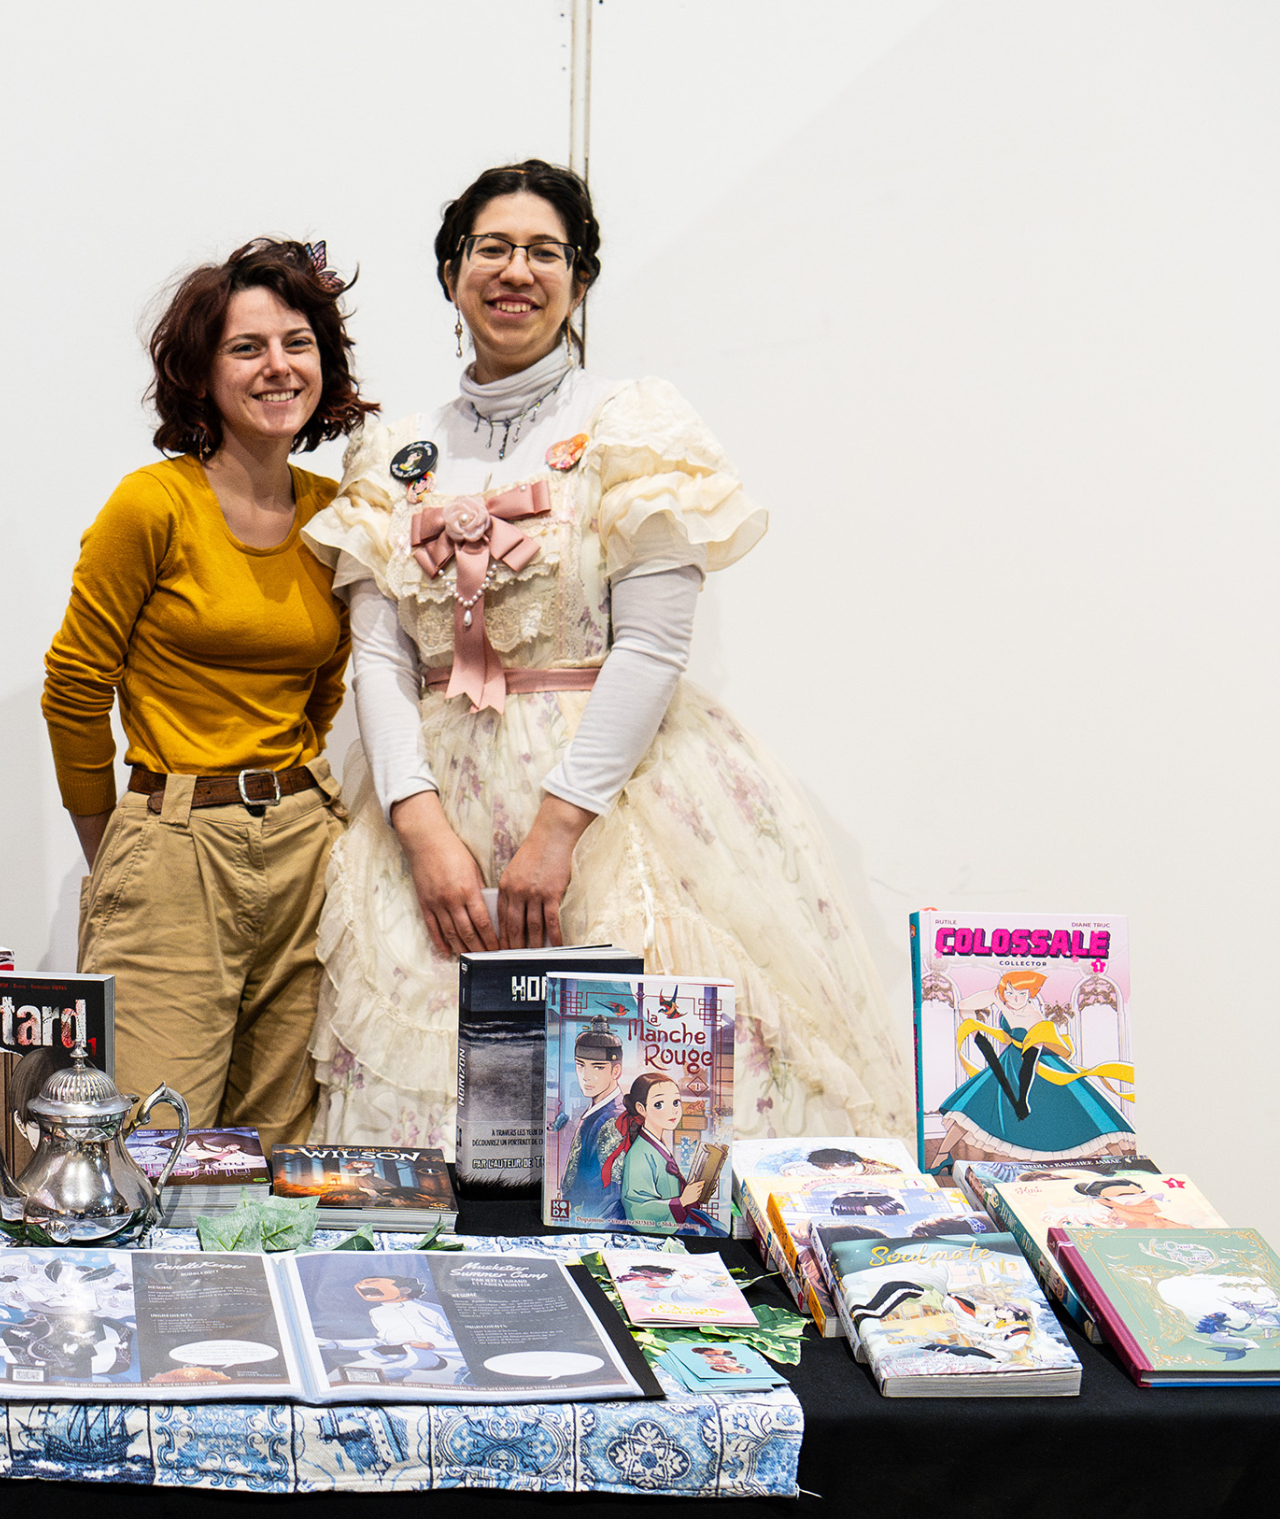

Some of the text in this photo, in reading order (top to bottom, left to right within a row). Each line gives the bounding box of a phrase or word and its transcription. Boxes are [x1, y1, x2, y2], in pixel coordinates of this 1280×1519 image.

[935, 927, 1111, 959] COLOSSALE
[1095, 961, 1101, 970] 1
[627, 1017, 707, 1048] Manche
[88, 1037, 97, 1056] 1
[644, 1045, 714, 1075] Rouge
[298, 1148, 421, 1162] WILSON
[472, 1159, 487, 1169] PAR
[488, 1158, 522, 1169] L'AUTEUR
[522, 1158, 533, 1168] DE
[869, 1241, 995, 1266] Soulmate
[449, 1269, 548, 1280] Summer Camp
